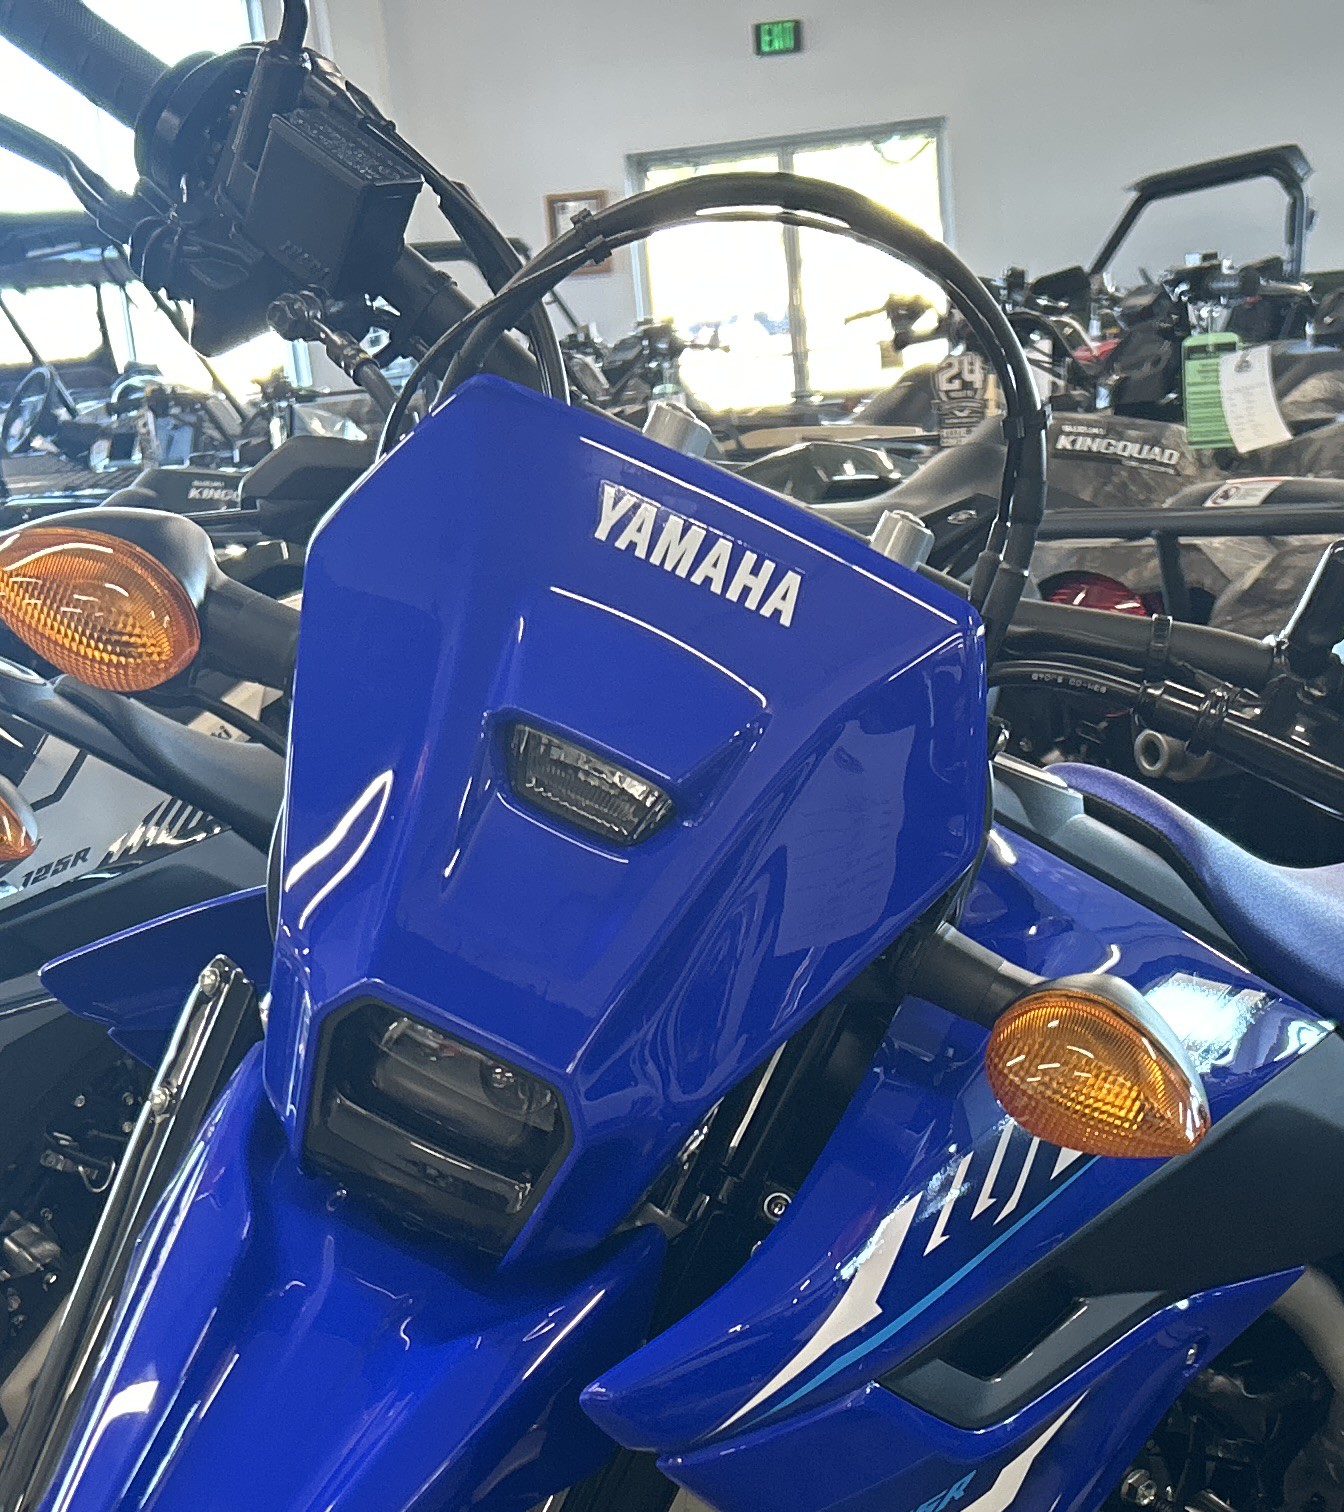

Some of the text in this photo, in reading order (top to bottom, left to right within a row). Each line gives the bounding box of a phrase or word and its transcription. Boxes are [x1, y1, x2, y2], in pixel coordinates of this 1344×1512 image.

[938, 355, 985, 391] 24
[1055, 434, 1181, 465] KINGQUAD
[594, 483, 802, 628] YAMAHA
[22, 847, 91, 890] 125R
